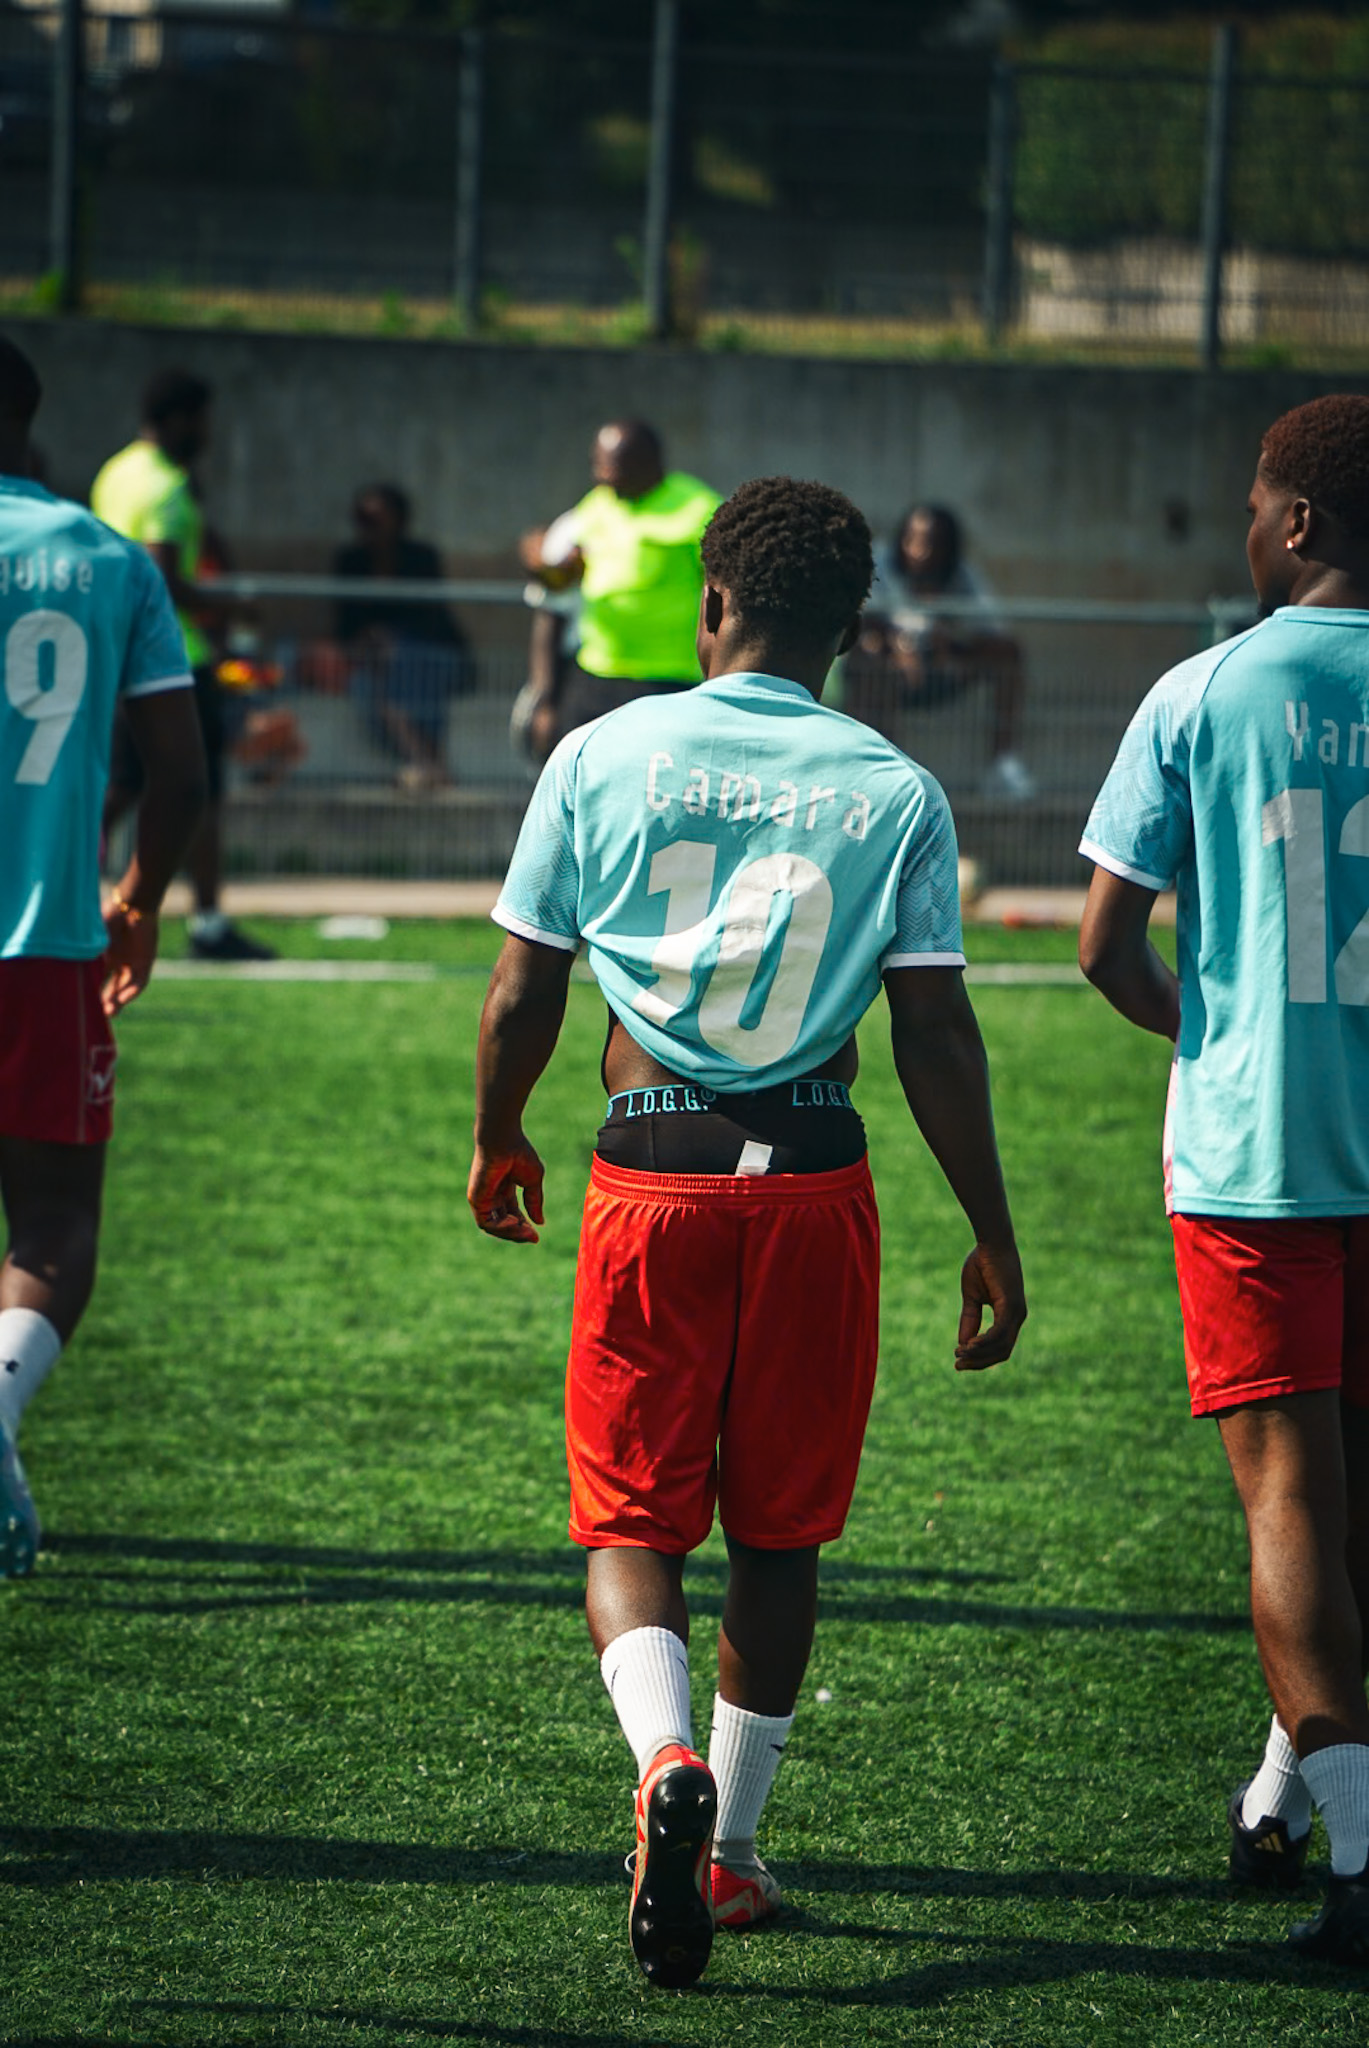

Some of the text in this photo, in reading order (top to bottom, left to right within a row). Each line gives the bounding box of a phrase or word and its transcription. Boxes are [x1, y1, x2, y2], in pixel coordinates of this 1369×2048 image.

[6, 608, 88, 785] 9
[646, 751, 871, 841] Camara
[631, 840, 833, 1067] 10
[626, 1087, 709, 1118] L.O.G.G.
